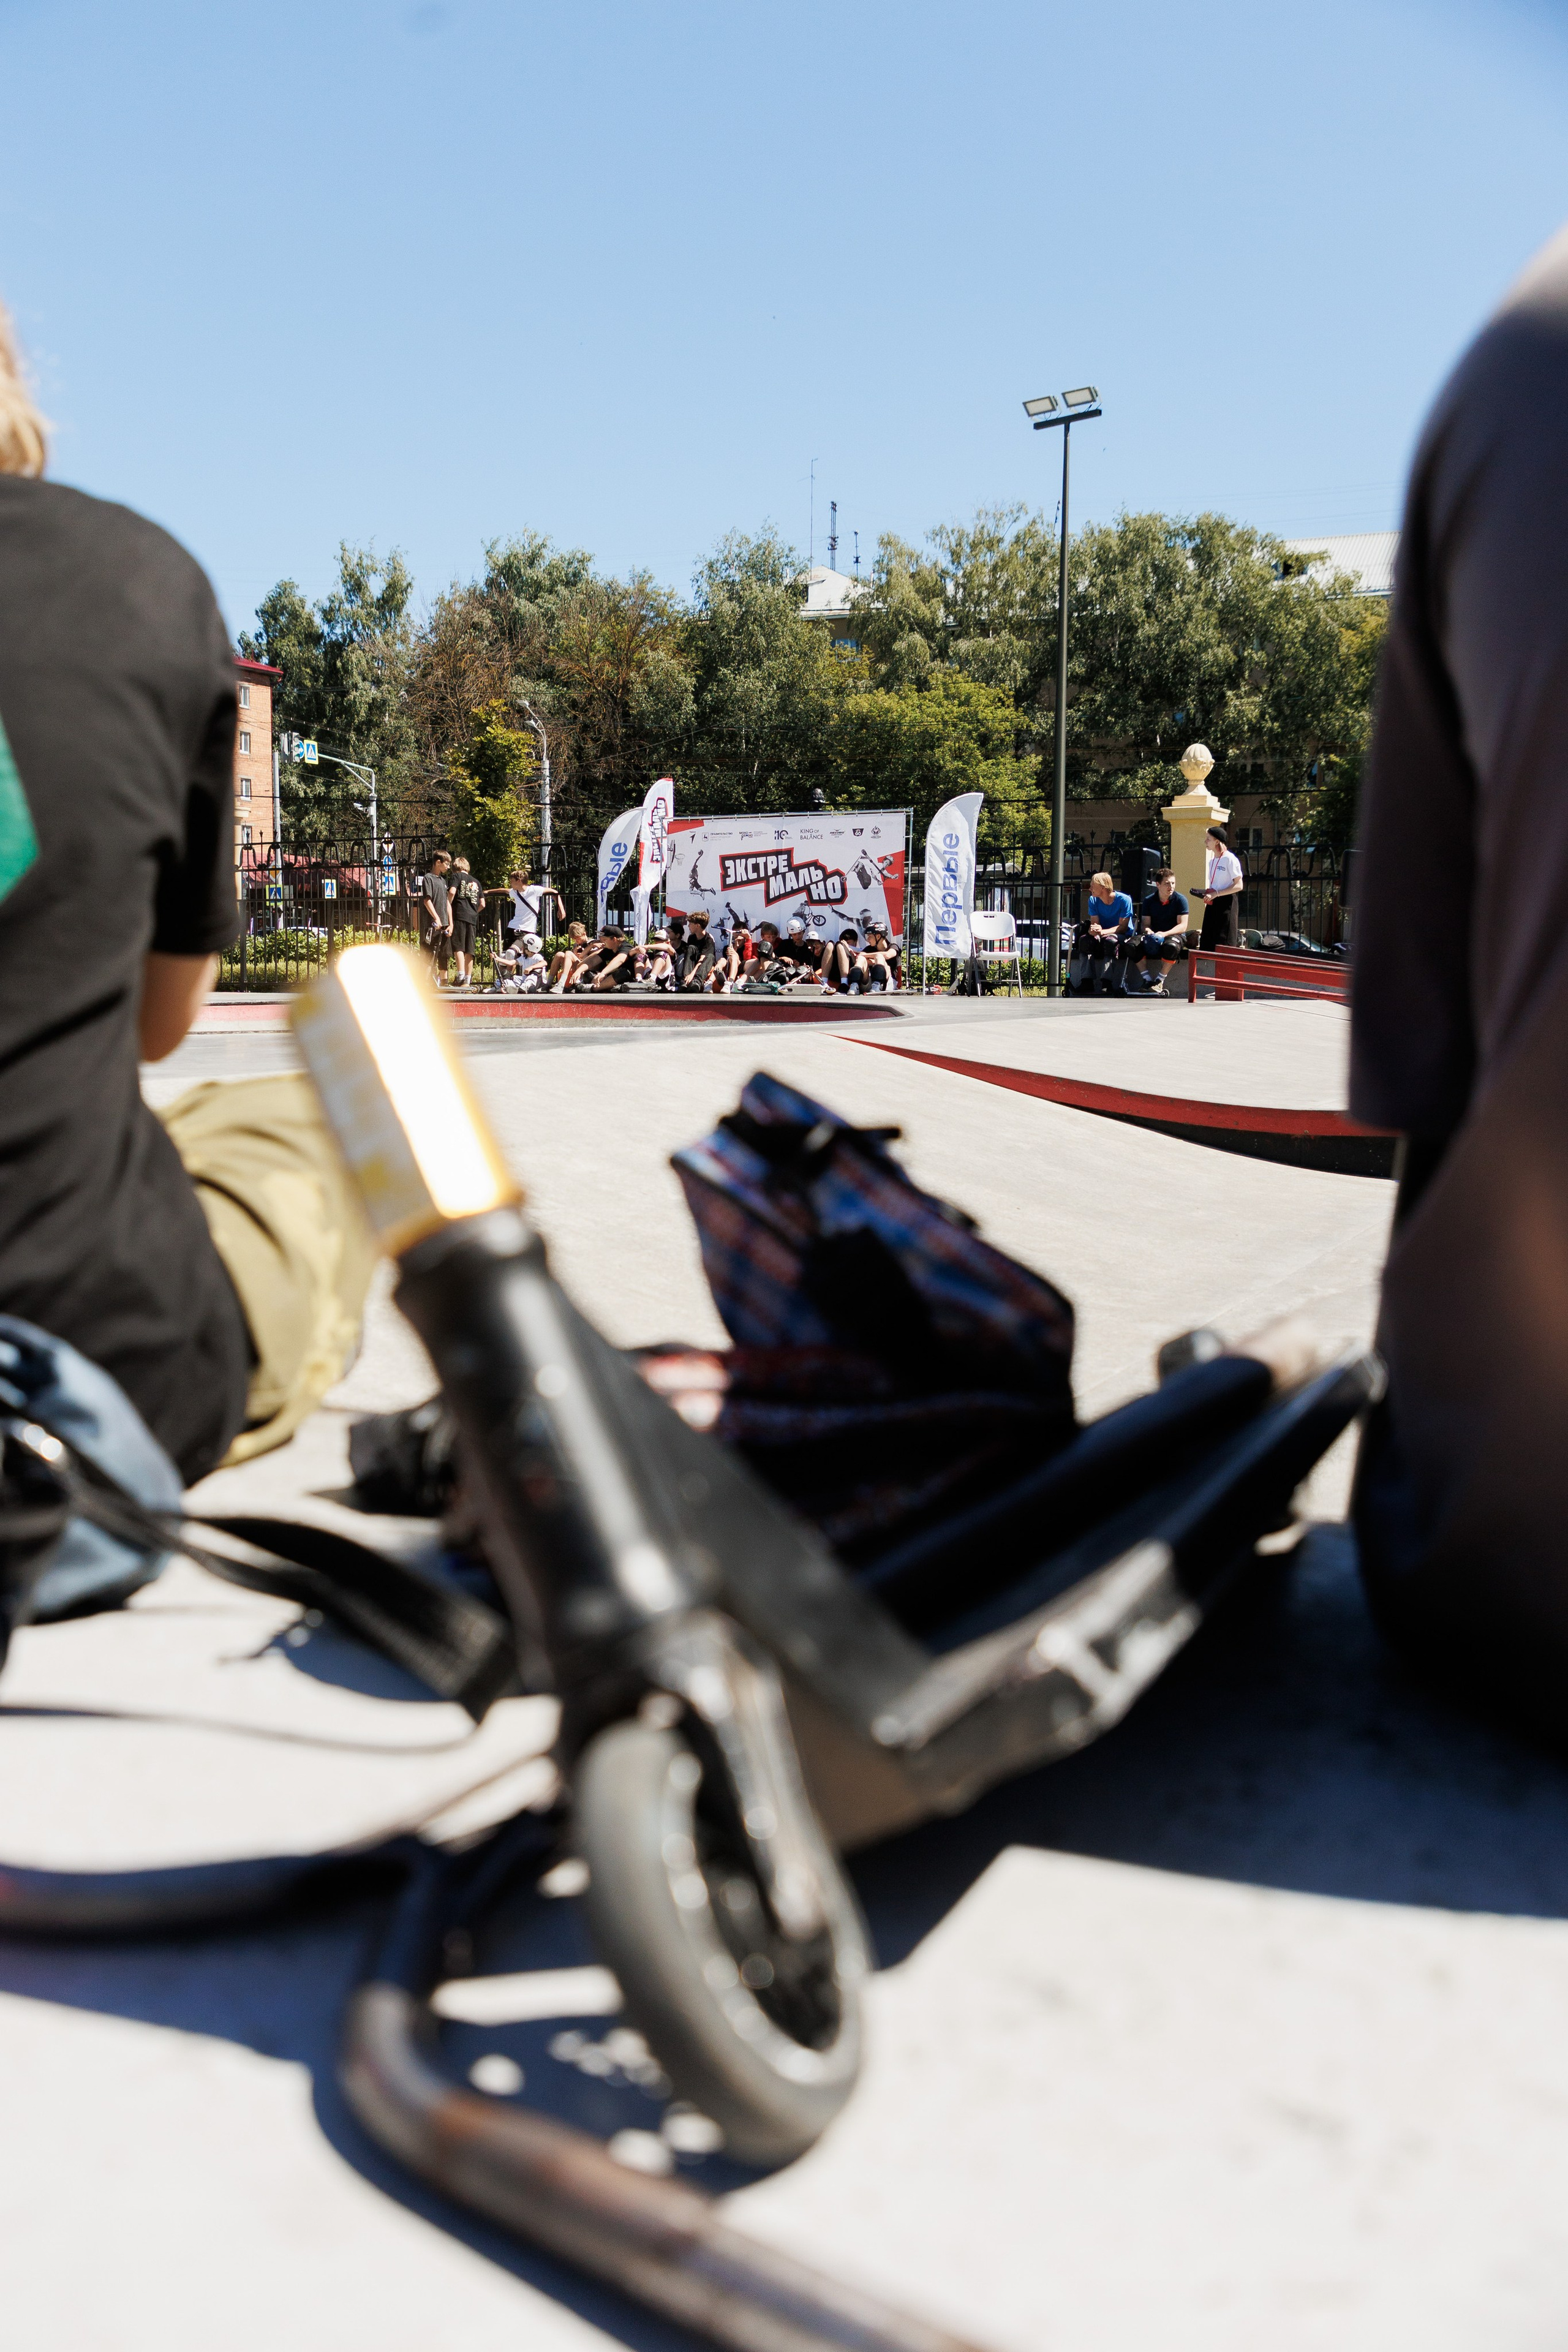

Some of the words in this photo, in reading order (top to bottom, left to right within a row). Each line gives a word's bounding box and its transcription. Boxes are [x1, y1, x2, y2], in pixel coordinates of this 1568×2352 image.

[725, 854, 789, 884] ЭКСТРЕ
[769, 866, 823, 899] МАЛЬ
[810, 875, 842, 900] НО
[935, 833, 962, 945] Первые
